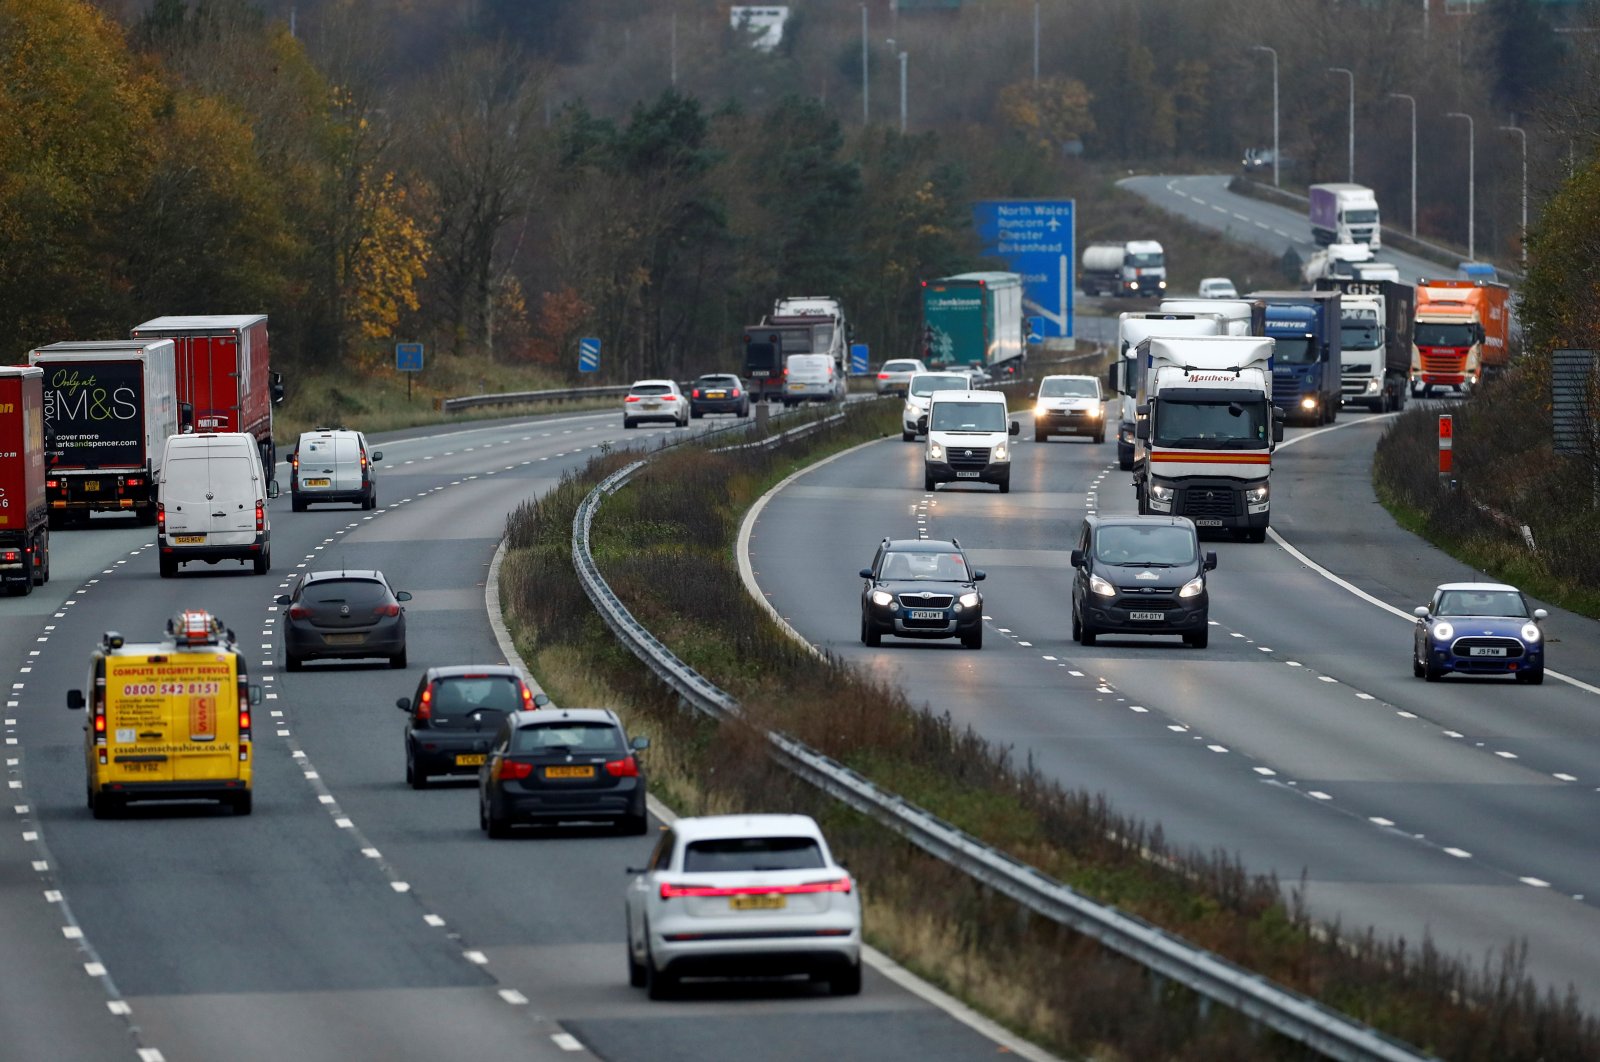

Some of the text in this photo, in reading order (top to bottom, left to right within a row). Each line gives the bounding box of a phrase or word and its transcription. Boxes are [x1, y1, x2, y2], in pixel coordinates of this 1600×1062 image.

[1347, 283, 1380, 295] GTS
[52, 369, 97, 396] Only at
[1188, 374, 1236, 383] Matthews
[44, 390, 55, 421] YOUR
[56, 387, 137, 421] M&S
[113, 666, 230, 676] COMPLETE SECURITY SERVICE
[124, 683, 218, 695] 0800 542 8151
